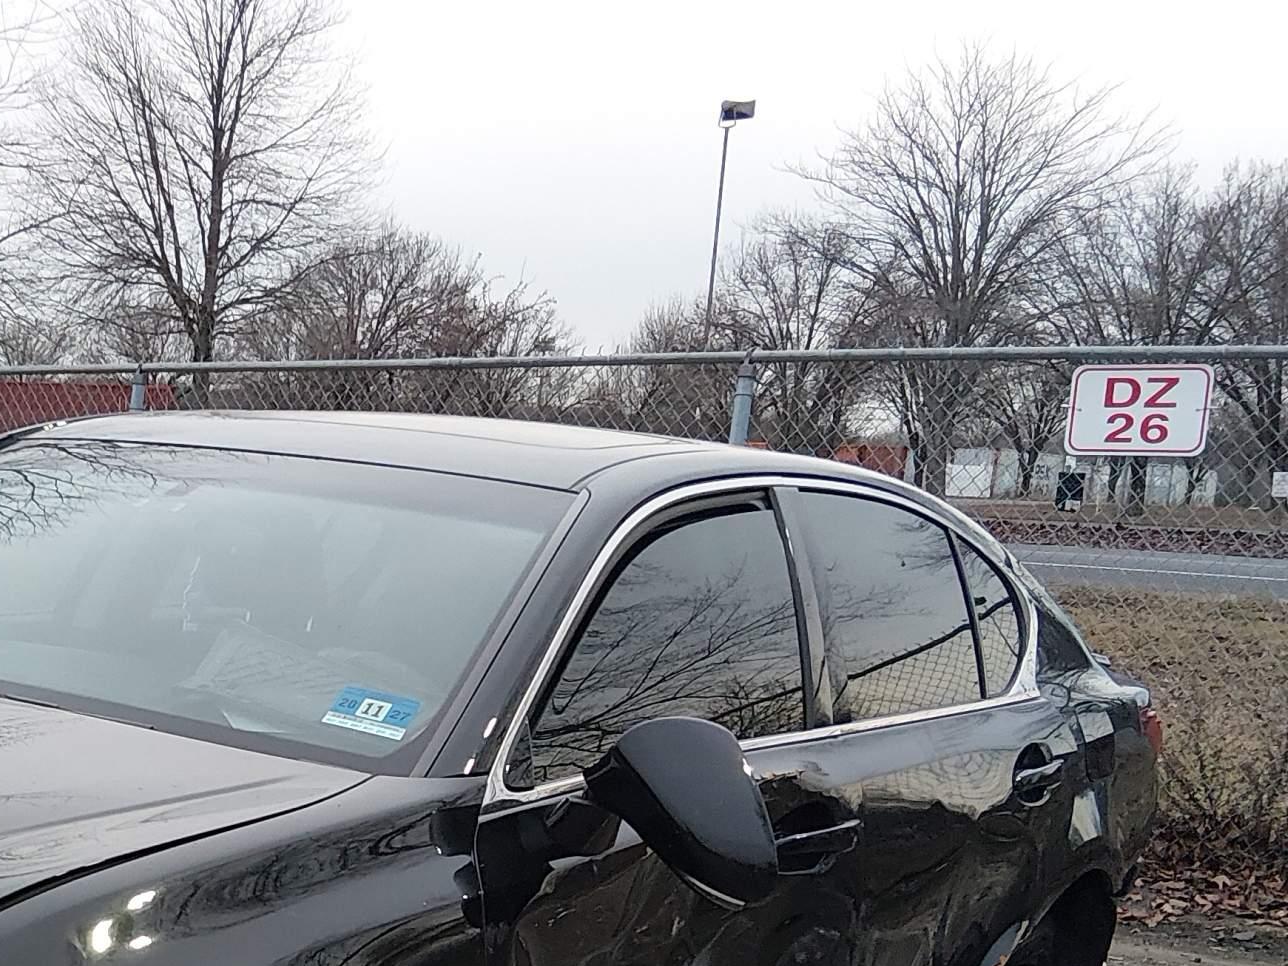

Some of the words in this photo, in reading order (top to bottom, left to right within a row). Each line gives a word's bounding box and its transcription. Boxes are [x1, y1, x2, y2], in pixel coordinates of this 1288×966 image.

[1103, 377, 1180, 408] DZ
[1103, 413, 1169, 444] 26
[338, 698, 358, 709] 20
[361, 702, 385, 718] 11
[389, 709, 411, 721] 27
